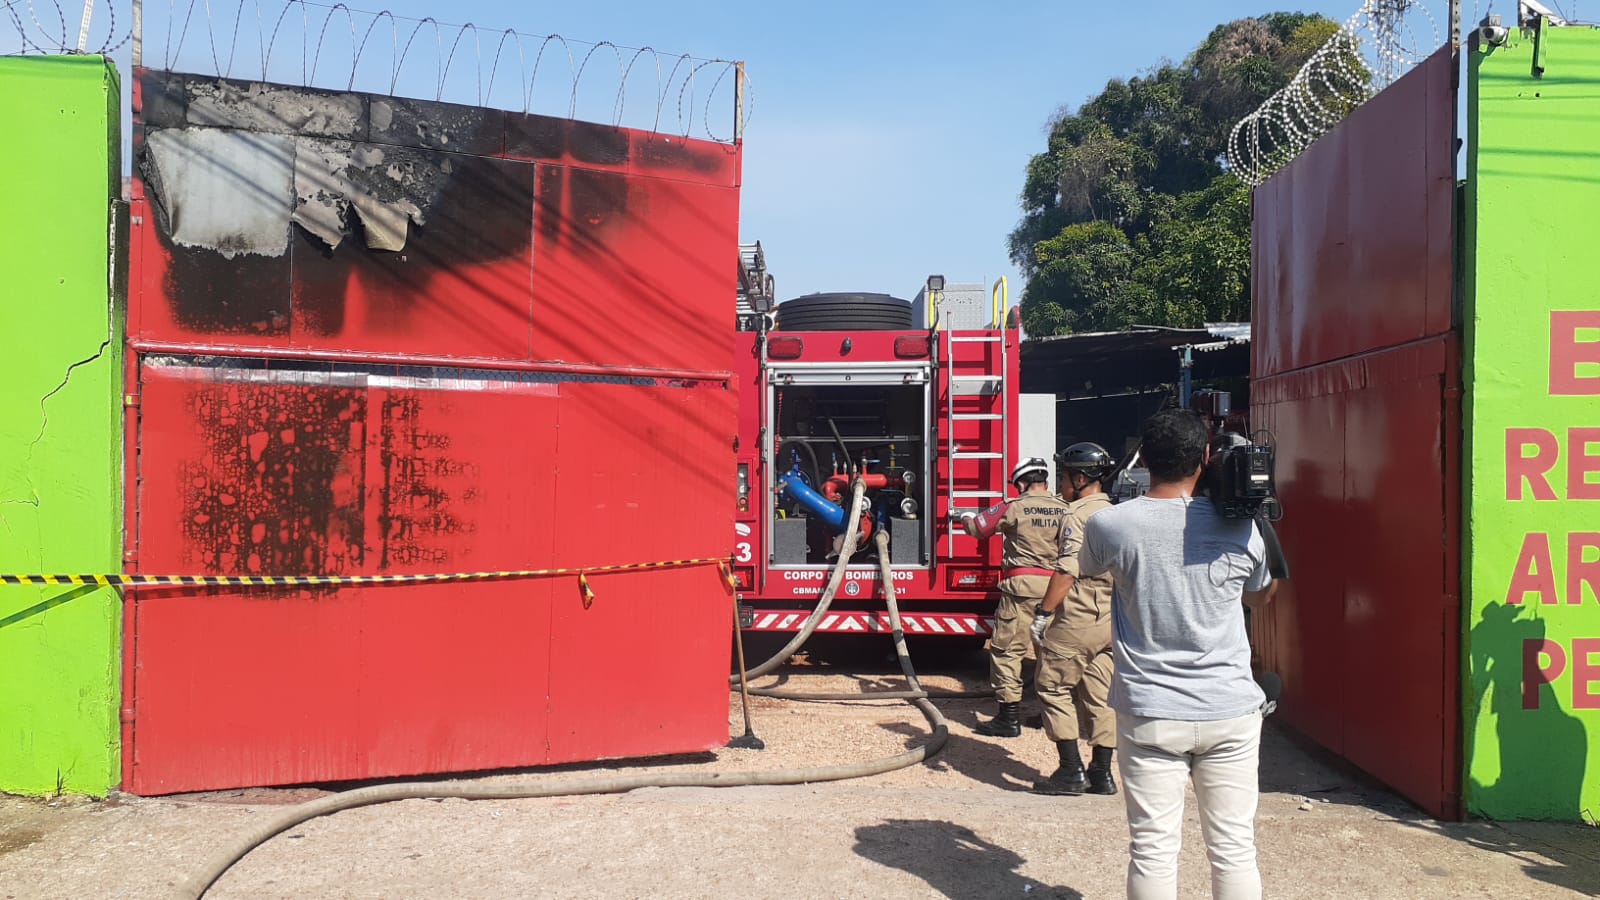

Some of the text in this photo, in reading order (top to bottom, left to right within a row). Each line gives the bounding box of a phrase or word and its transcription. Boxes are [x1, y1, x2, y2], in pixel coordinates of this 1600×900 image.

[1505, 428, 1600, 501] RE
[783, 571, 824, 581] CORPO
[1505, 531, 1600, 605] AR
[1521, 637, 1600, 710] PE
